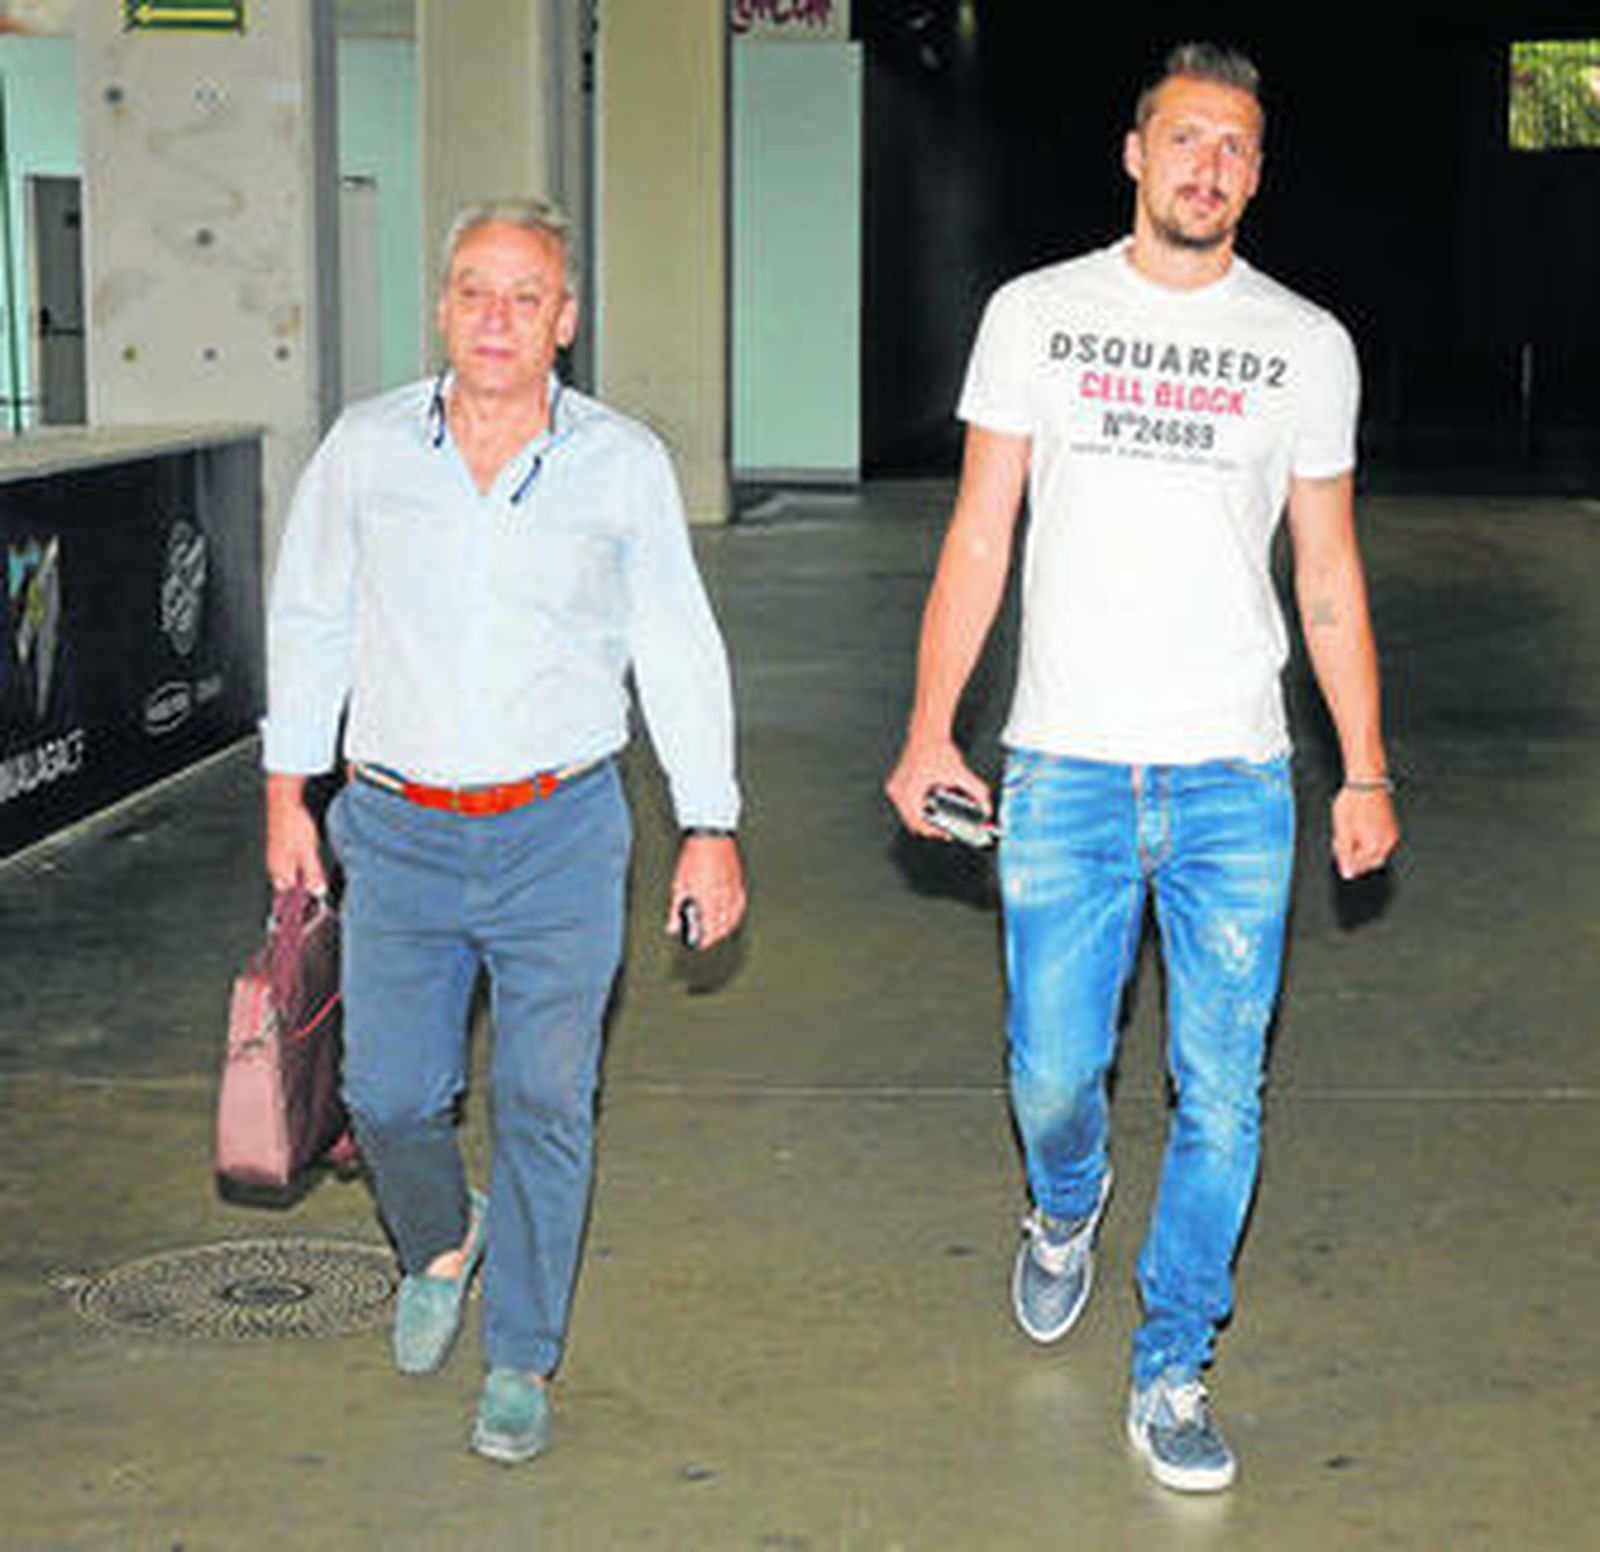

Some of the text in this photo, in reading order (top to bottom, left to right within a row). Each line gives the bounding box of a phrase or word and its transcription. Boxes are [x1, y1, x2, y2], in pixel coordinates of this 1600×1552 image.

[1050, 331, 1288, 388] DSQUARED2
[1079, 371, 1245, 416] CELL BLOCK
